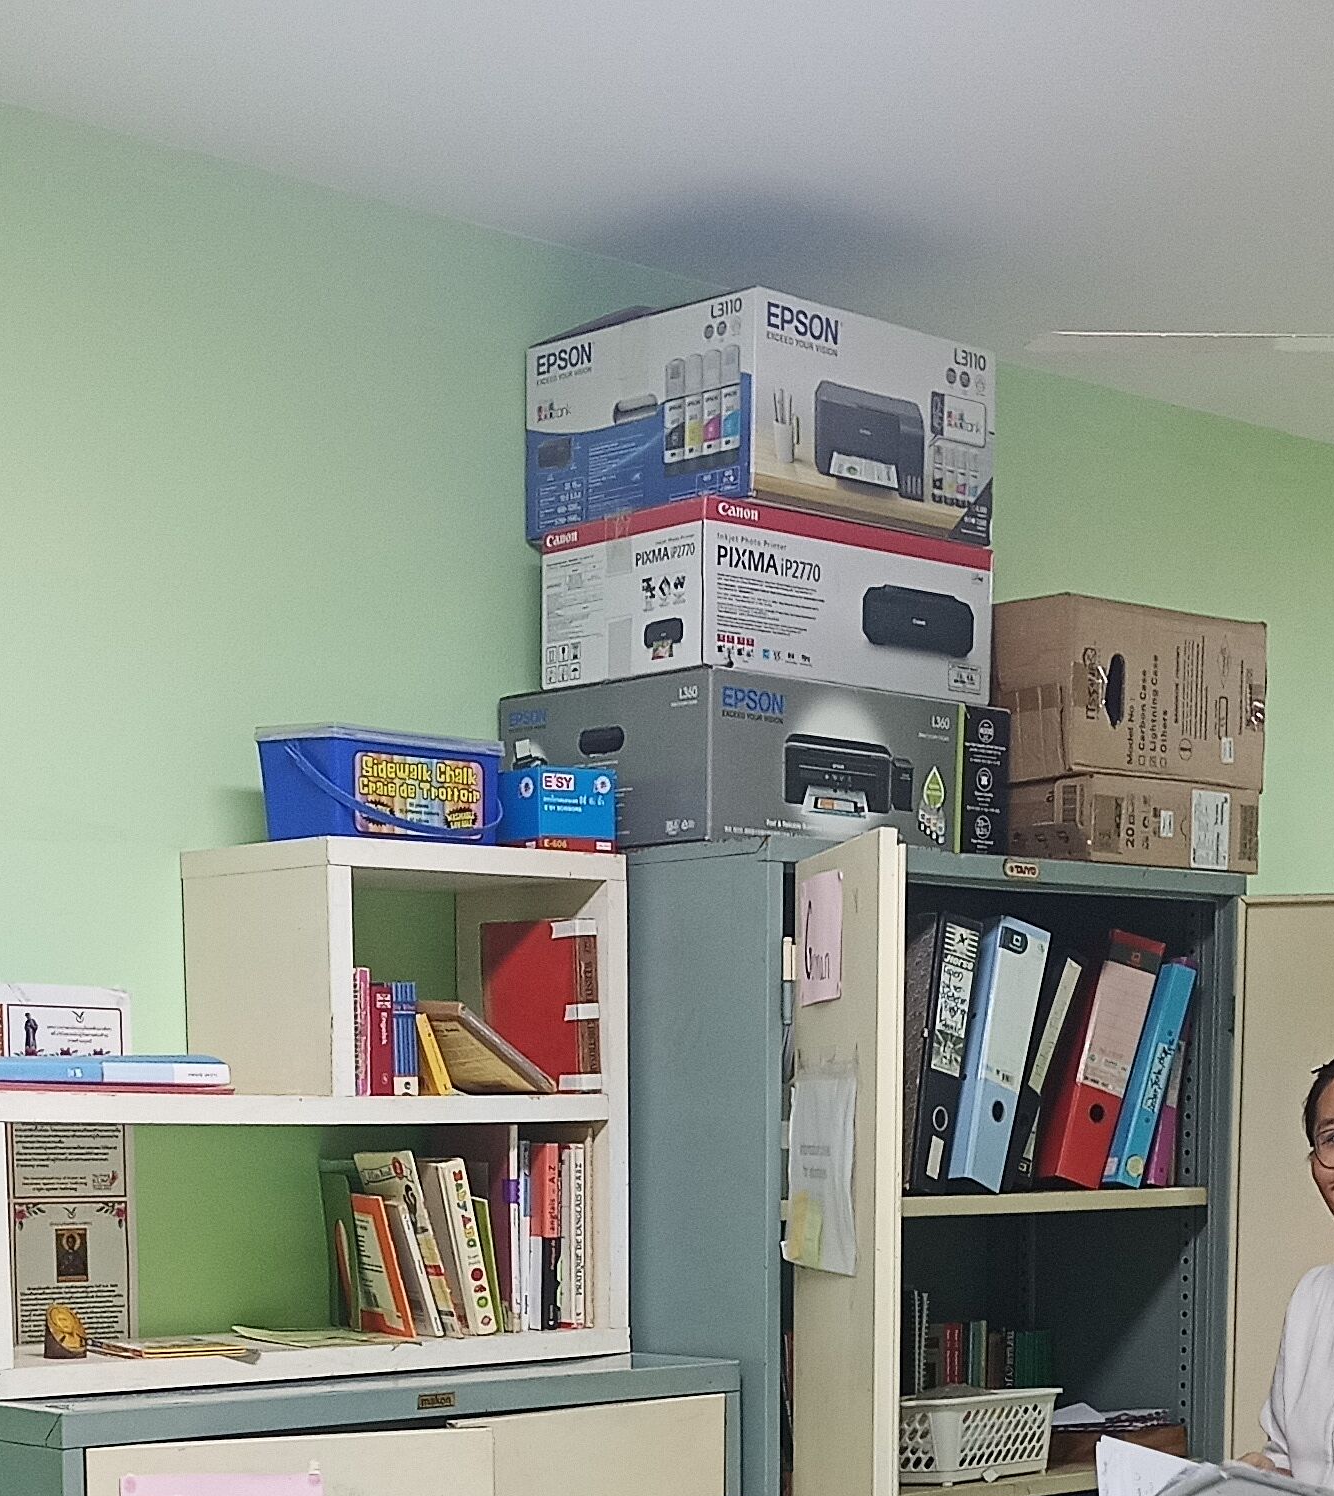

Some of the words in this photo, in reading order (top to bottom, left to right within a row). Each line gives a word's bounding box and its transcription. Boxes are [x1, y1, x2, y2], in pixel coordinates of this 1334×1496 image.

[710, 298, 743, 319] L3110
[767, 301, 839, 345] EPSON
[536, 341, 593, 376] EPSON
[954, 348, 987, 371] L3110
[718, 501, 759, 522] Canon
[546, 530, 578, 548] Canon
[717, 531, 739, 544] Inkjet
[741, 536, 762, 547] Photo
[635, 546, 670, 568] PIXMA
[717, 544, 779, 576] PIXMA
[780, 558, 821, 583] iP2770
[679, 686, 698, 700] L360
[722, 686, 785, 714] EPSON
[509, 709, 548, 728] EPSON
[932, 716, 950, 730] L360
[1138, 704, 1147, 751] Carbon
[361, 755, 432, 782] Sidewalk
[436, 762, 477, 785] Chalk
[358, 776, 397, 798] Craie
[399, 781, 417, 799] de
[419, 783, 481, 804] Trottoir
